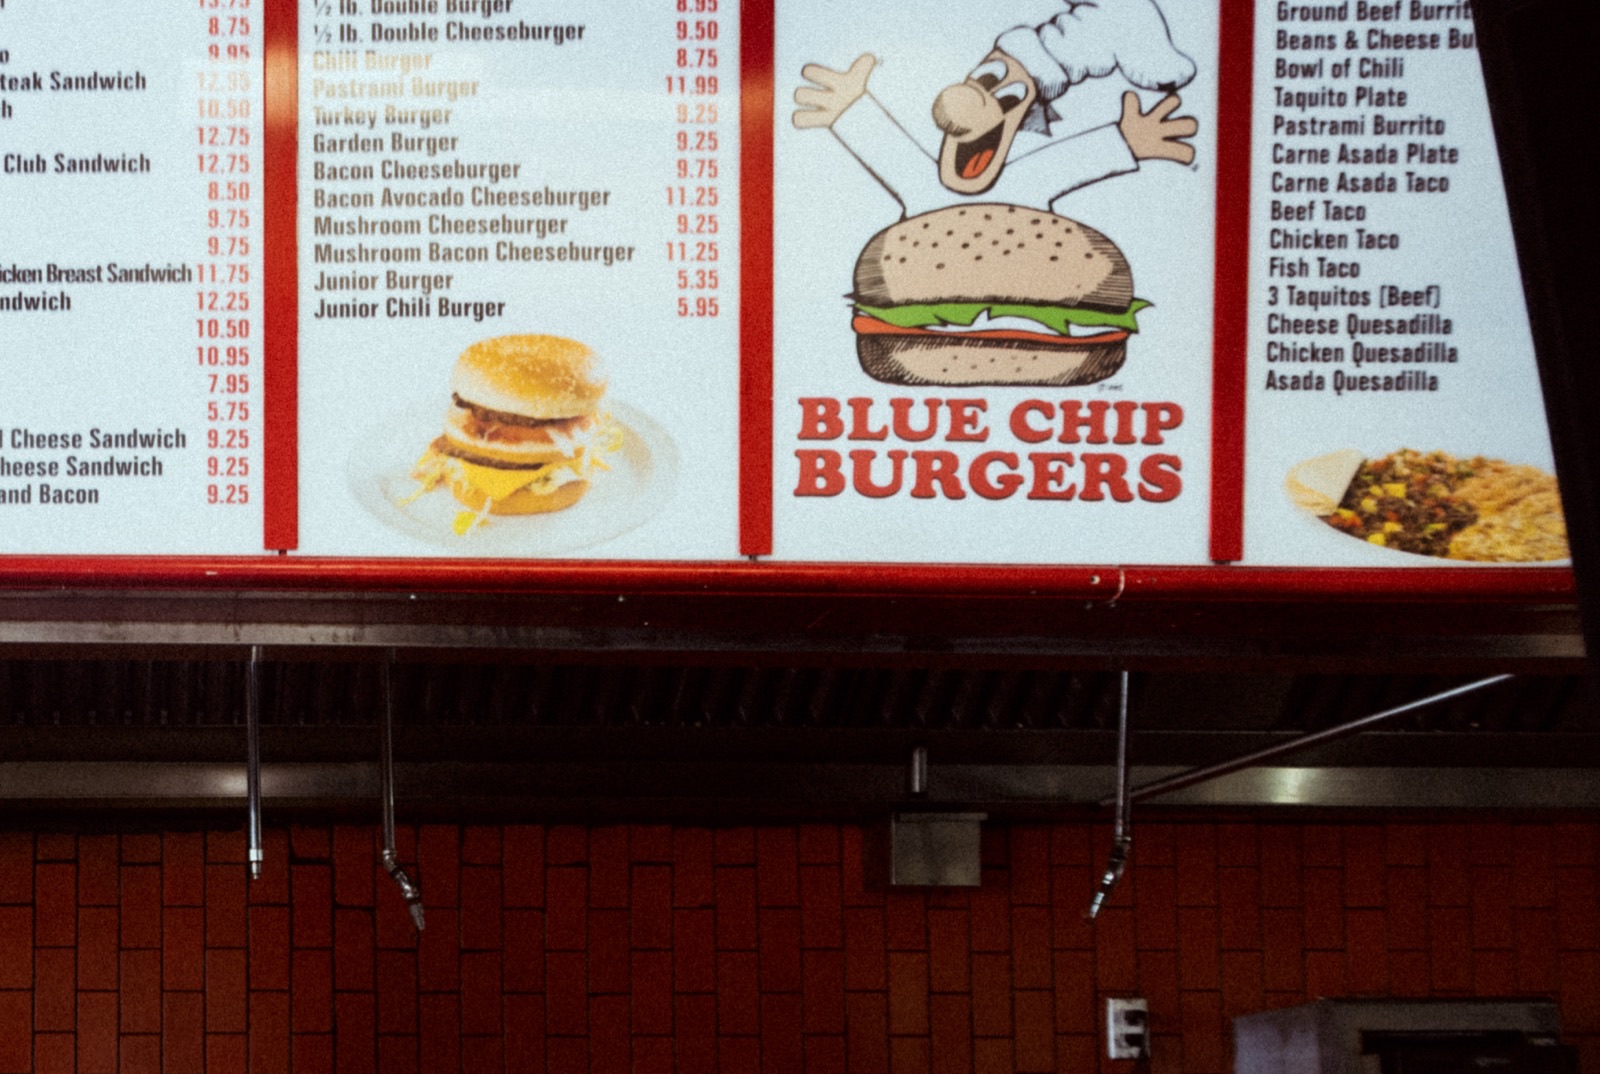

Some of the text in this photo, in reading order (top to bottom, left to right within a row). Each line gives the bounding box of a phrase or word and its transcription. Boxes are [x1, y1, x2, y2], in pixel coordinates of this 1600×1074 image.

[1277, 1, 1471, 21] Ground Beef Burrit
[1276, 29, 1336, 50] Beans
[1344, 30, 1358, 50] &
[1367, 28, 1440, 50] Cheese
[1275, 57, 1404, 79] Bowl of Chili
[50, 71, 146, 91] Sandwich
[1275, 85, 1407, 111] Taquito Plate
[1273, 114, 1445, 135] Pastrami Burrito
[198, 126, 250, 146] 12.75
[313, 130, 718, 156] Garden Burger 9.25
[1272, 143, 1459, 164] Carne Asada Plate
[314, 159, 718, 184] Bacon Cheeseburger 9.75
[1271, 170, 1449, 194] Carne Asada Taco
[208, 181, 250, 201] 8.50
[314, 185, 719, 211] Bacon Avocado Cheeseburger 11.25
[208, 209, 250, 228] 9.75
[1271, 200, 1366, 221] Beef Taco
[314, 213, 718, 238] Mushroom Cheeseburger 9.25
[208, 235, 249, 257] 9.75
[1270, 228, 1399, 250] Chicken Taco
[314, 240, 719, 267] Mushroom Bacon Cheeseburger 11.25
[1269, 256, 1360, 278] Fish Taco
[314, 269, 719, 296] Junior Burger 5.35
[198, 291, 249, 312] 12.25
[1268, 286, 1278, 306] 3
[1288, 285, 1371, 309] Taquitos
[314, 296, 719, 322] Junior Chili Burger 5.95
[197, 319, 250, 338] 10.50
[1267, 313, 1453, 338] Cheese Quesadilla
[198, 346, 249, 366] 10.95
[1267, 341, 1458, 367] Chicken Quesadilla
[209, 373, 249, 395] 7.95
[1265, 369, 1438, 395] Asada Quesadilla
[208, 401, 249, 421] 5.75
[798, 397, 1184, 446] BLUE CHIP
[793, 449, 1182, 502] BURGERS
[39, 483, 99, 505] Bacon
[207, 484, 249, 505] 9.25
